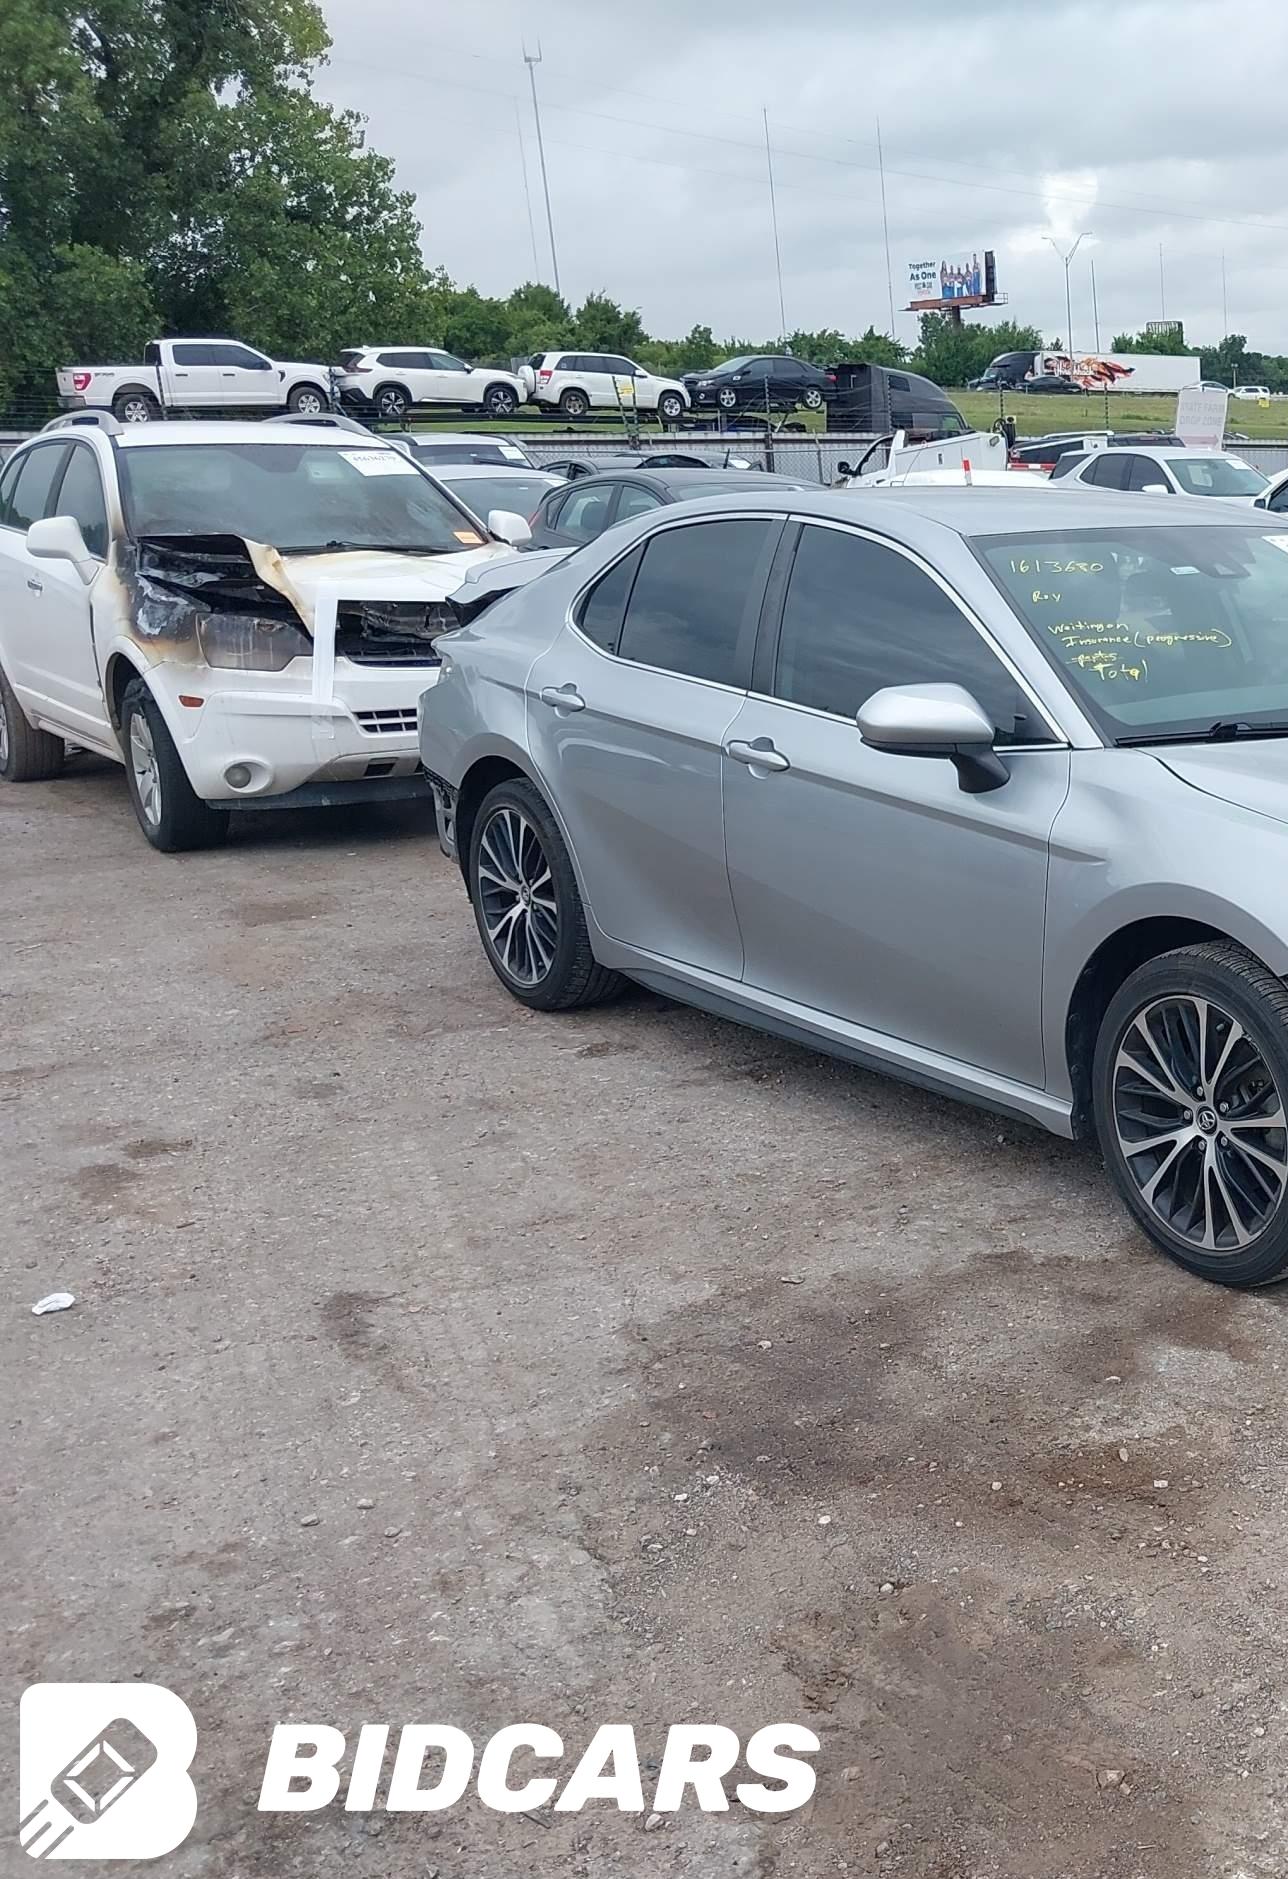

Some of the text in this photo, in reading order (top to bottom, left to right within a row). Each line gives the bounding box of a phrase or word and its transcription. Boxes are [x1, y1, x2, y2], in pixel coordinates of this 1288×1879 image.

[908, 261, 936, 271] Together
[910, 271, 937, 281] As One
